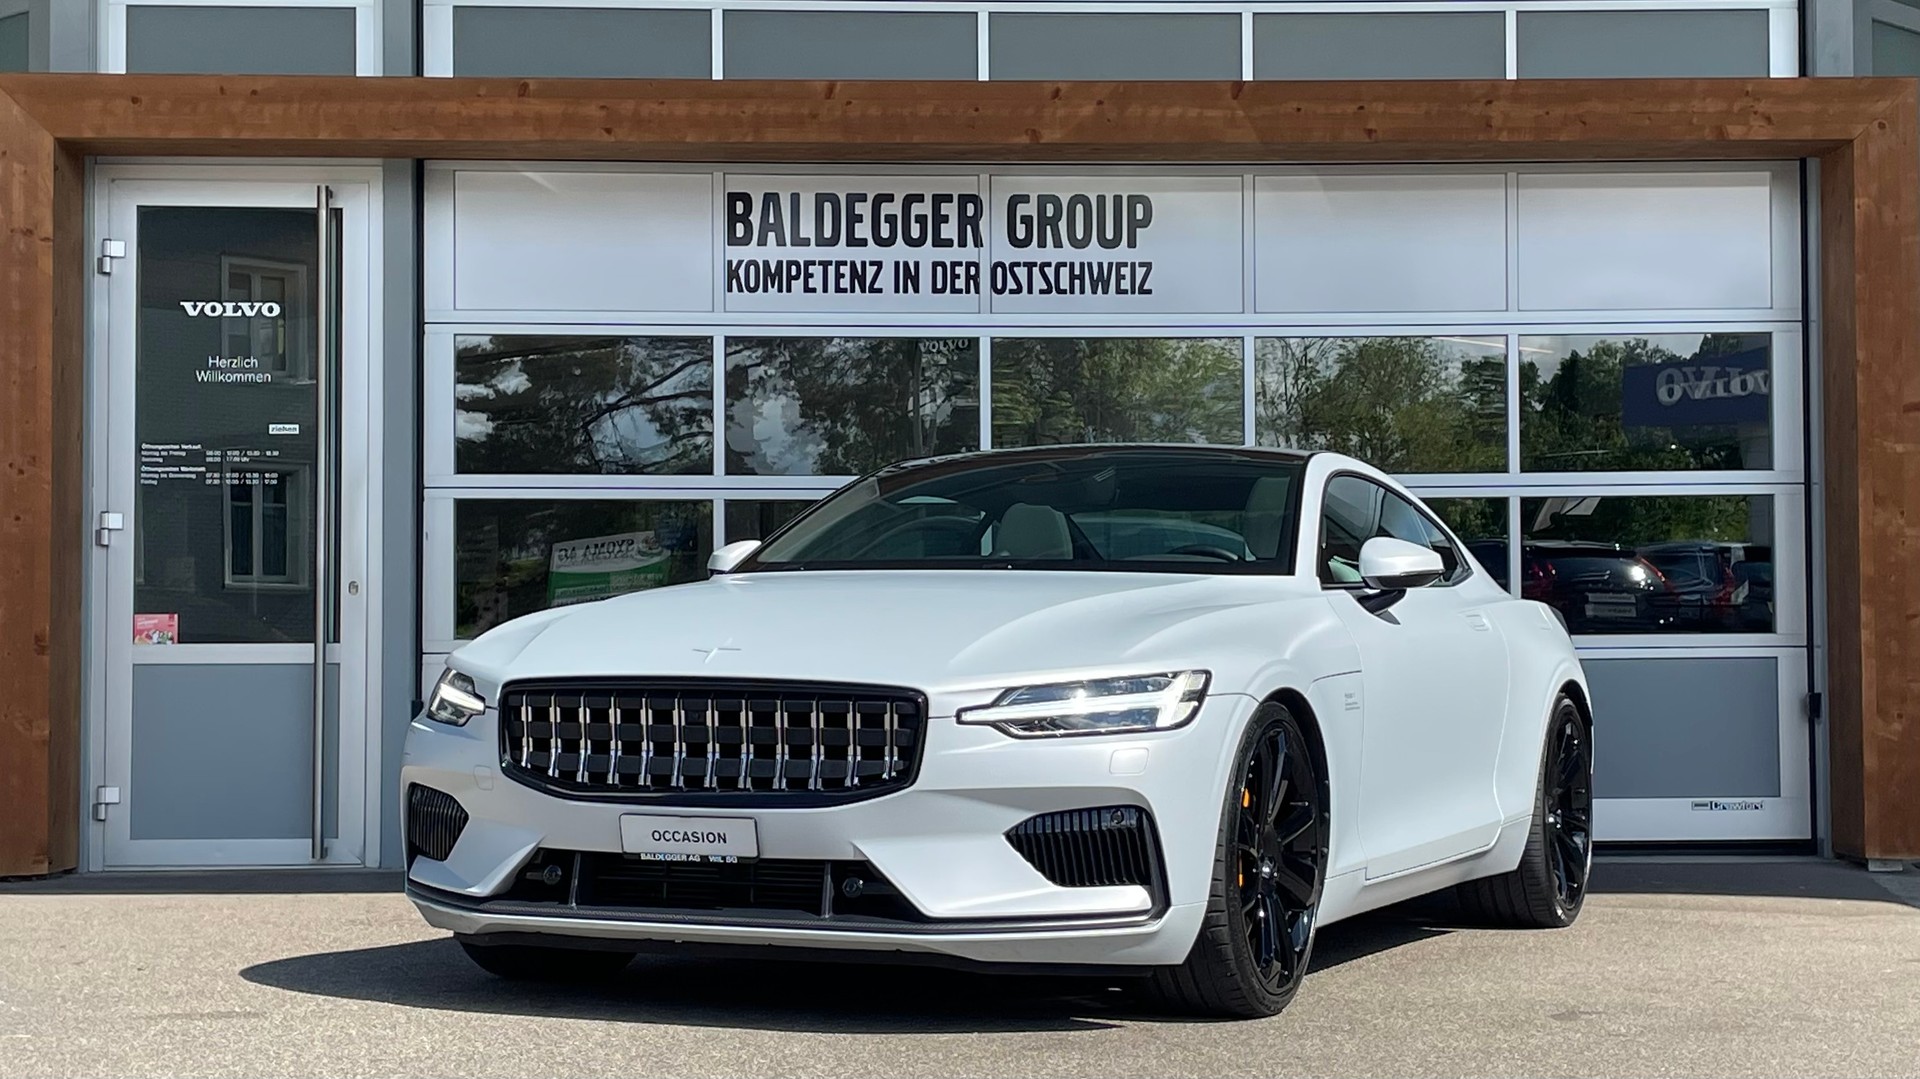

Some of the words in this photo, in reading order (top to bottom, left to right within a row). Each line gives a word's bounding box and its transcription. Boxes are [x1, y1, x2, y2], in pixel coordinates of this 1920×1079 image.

[727, 192, 984, 248] BALDEGGER
[1007, 193, 1153, 250] GROUP
[726, 260, 883, 294] KOMPETENZ
[894, 260, 920, 295] IN
[931, 260, 980, 295] DER
[991, 260, 1153, 296] OSTSCHWEIZ
[180, 302, 281, 317] VOLVO
[919, 339, 969, 353] VOLVO
[208, 355, 259, 369] Herzlich
[195, 370, 272, 383] Willkommen
[651, 829, 727, 844] OCCASION
[640, 853, 687, 862] BALDEGGER
[688, 854, 701, 862] AG
